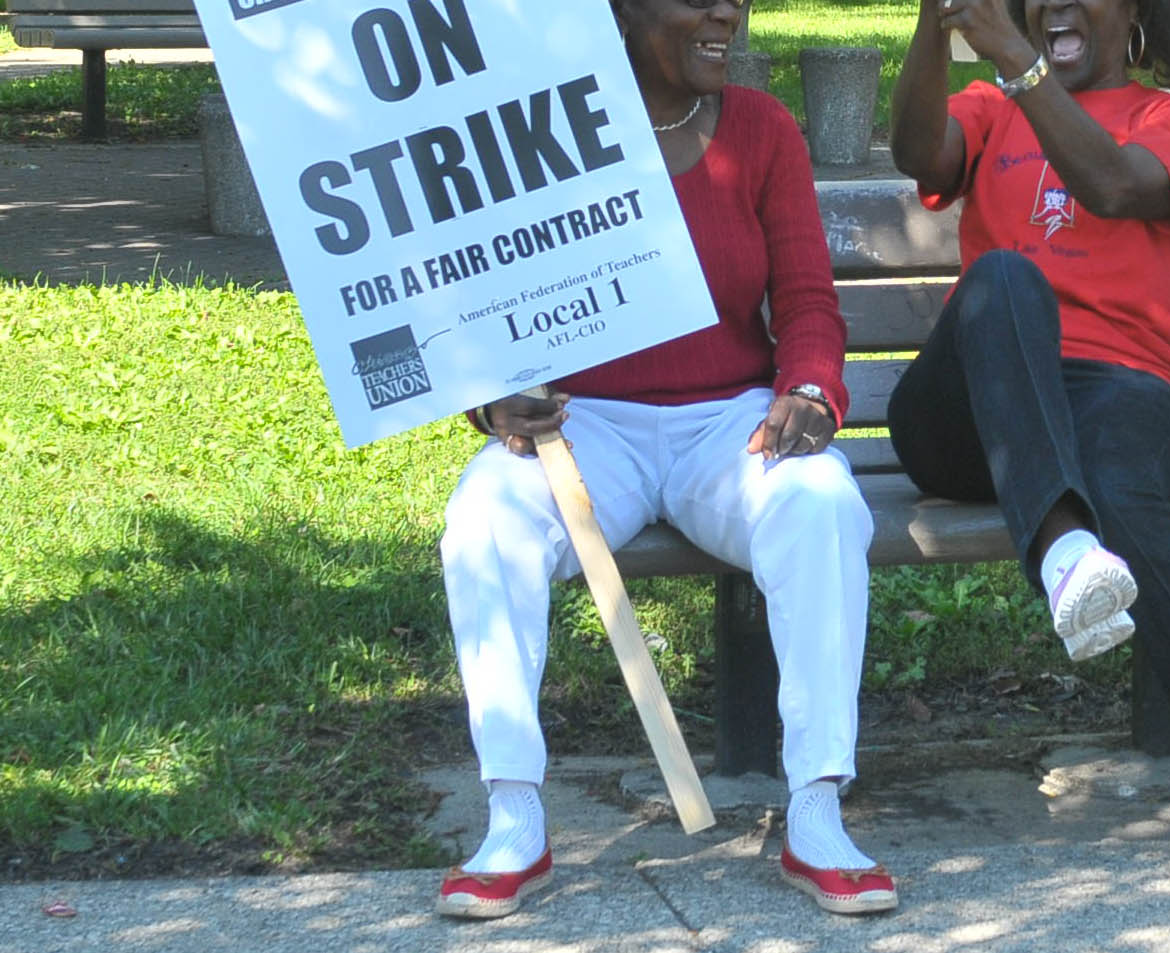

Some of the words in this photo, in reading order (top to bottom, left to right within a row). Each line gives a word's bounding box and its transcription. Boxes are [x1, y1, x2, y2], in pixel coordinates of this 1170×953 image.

[300, 75, 624, 255] STRIKE
[341, 275, 398, 316] FOR
[401, 267, 422, 298] A
[424, 244, 490, 289] FAIR
[493, 190, 642, 265] CONTRACT
[459, 297, 518, 324] American
[520, 274, 588, 303] Federation
[591, 264, 603, 279] of
[607, 249, 660, 273] Teachers
[504, 287, 602, 342] Local
[609, 277, 630, 307] 1
[547, 320, 606, 349] AFL-CIO
[367, 371, 429, 405] UNION
